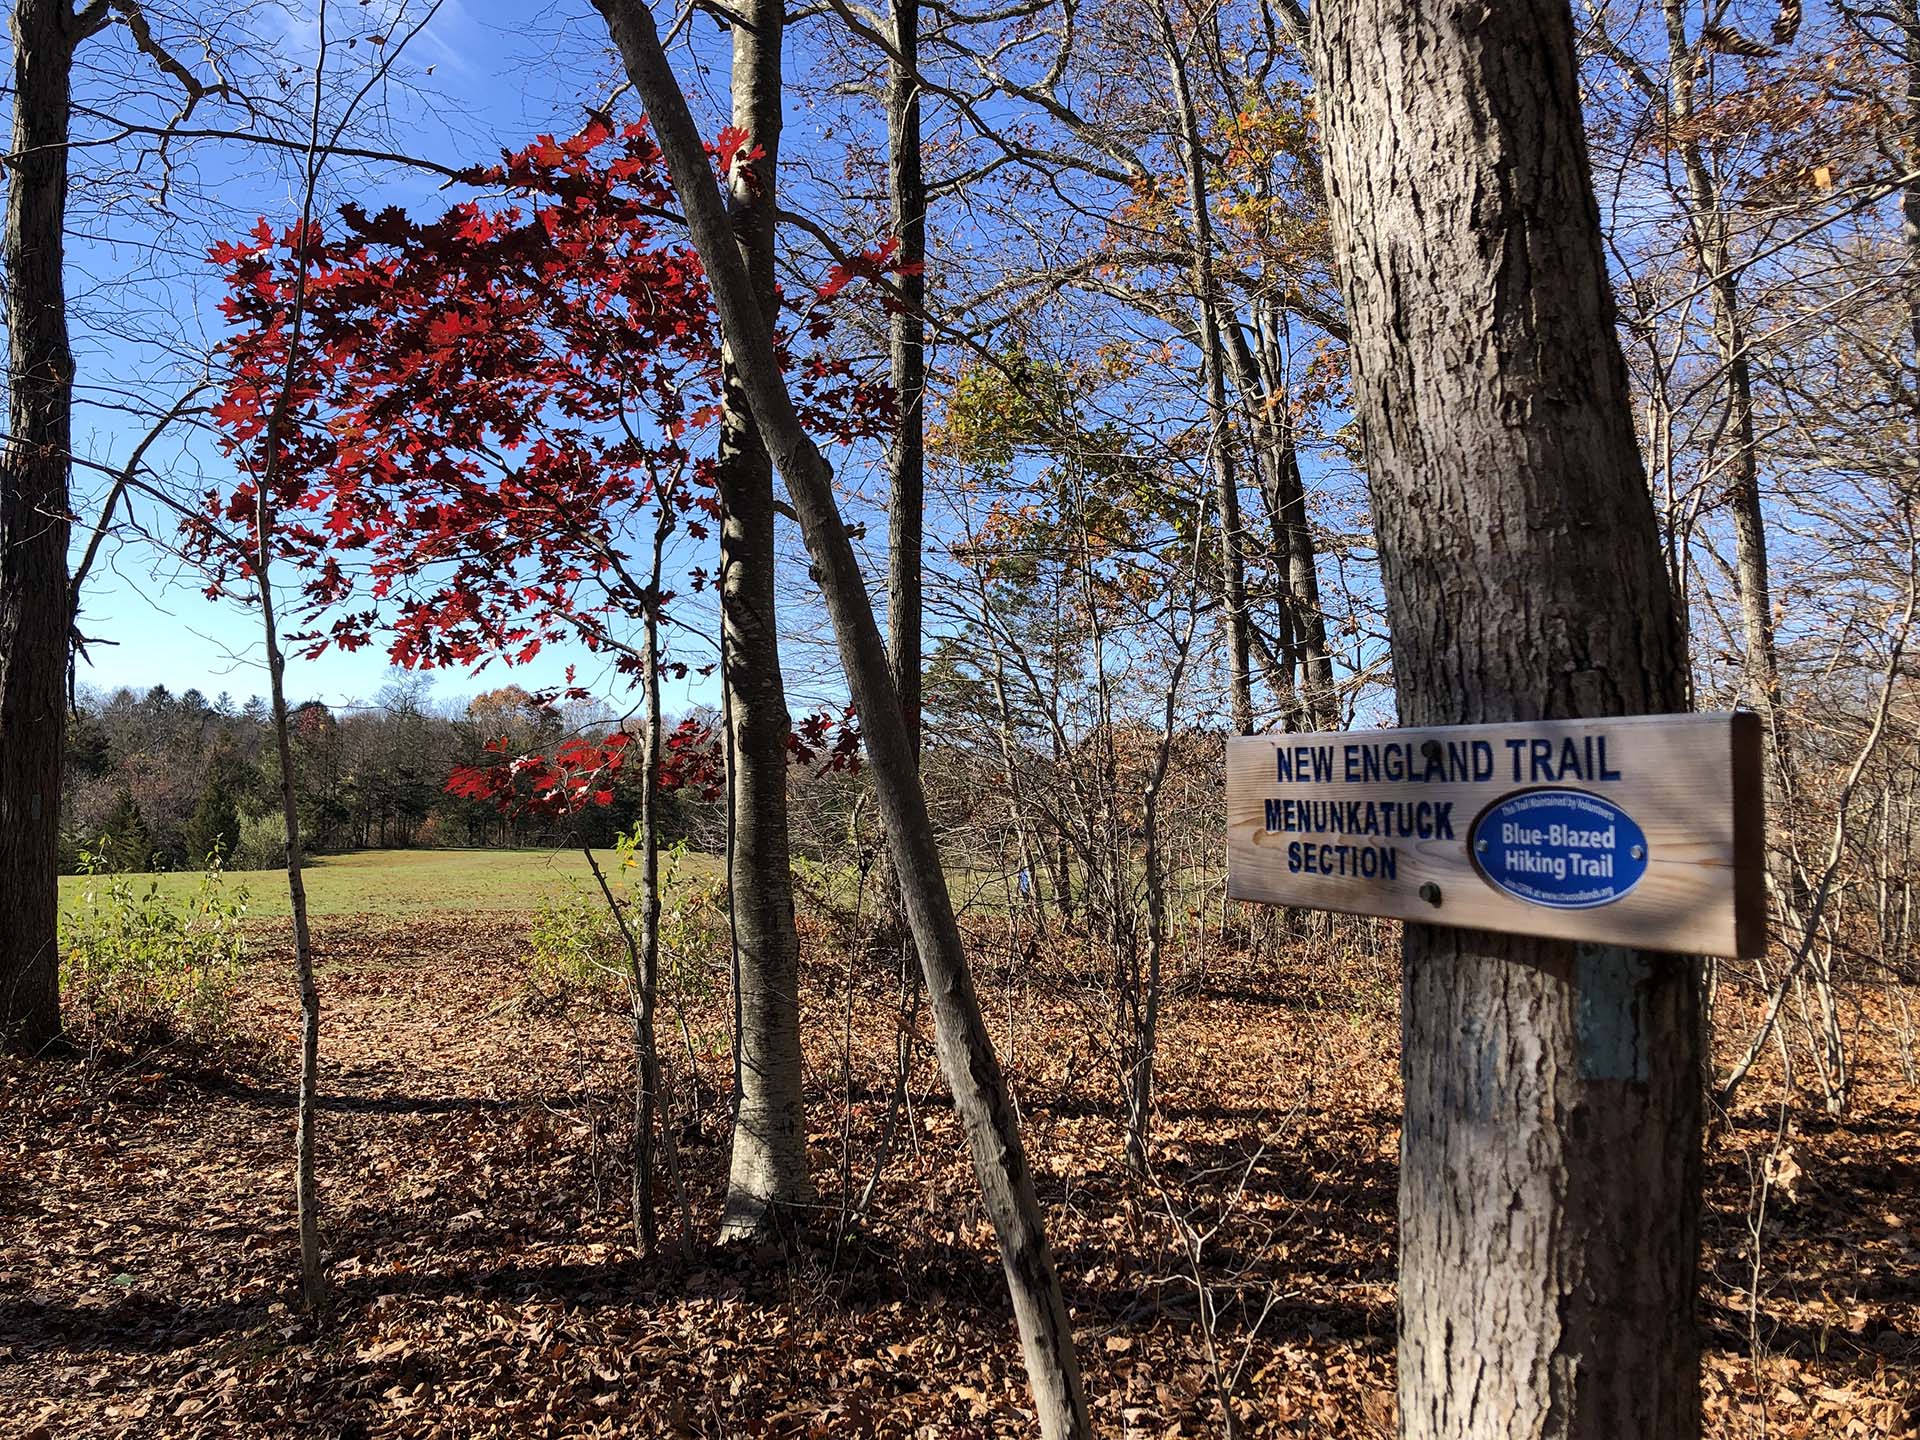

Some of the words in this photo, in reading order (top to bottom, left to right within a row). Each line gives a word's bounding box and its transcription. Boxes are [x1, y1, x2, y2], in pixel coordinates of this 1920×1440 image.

[1276, 745, 1334, 783] NEW
[1344, 739, 1494, 783] ENGLAND
[1505, 735, 1622, 782] TRAIL
[1264, 798, 1455, 840] MENUNKATUCK
[1501, 822, 1616, 849] Blue-Blazed
[1287, 841, 1398, 880] SECTION
[1504, 849, 1566, 880] Hiking
[1568, 852, 1614, 878] Trail
